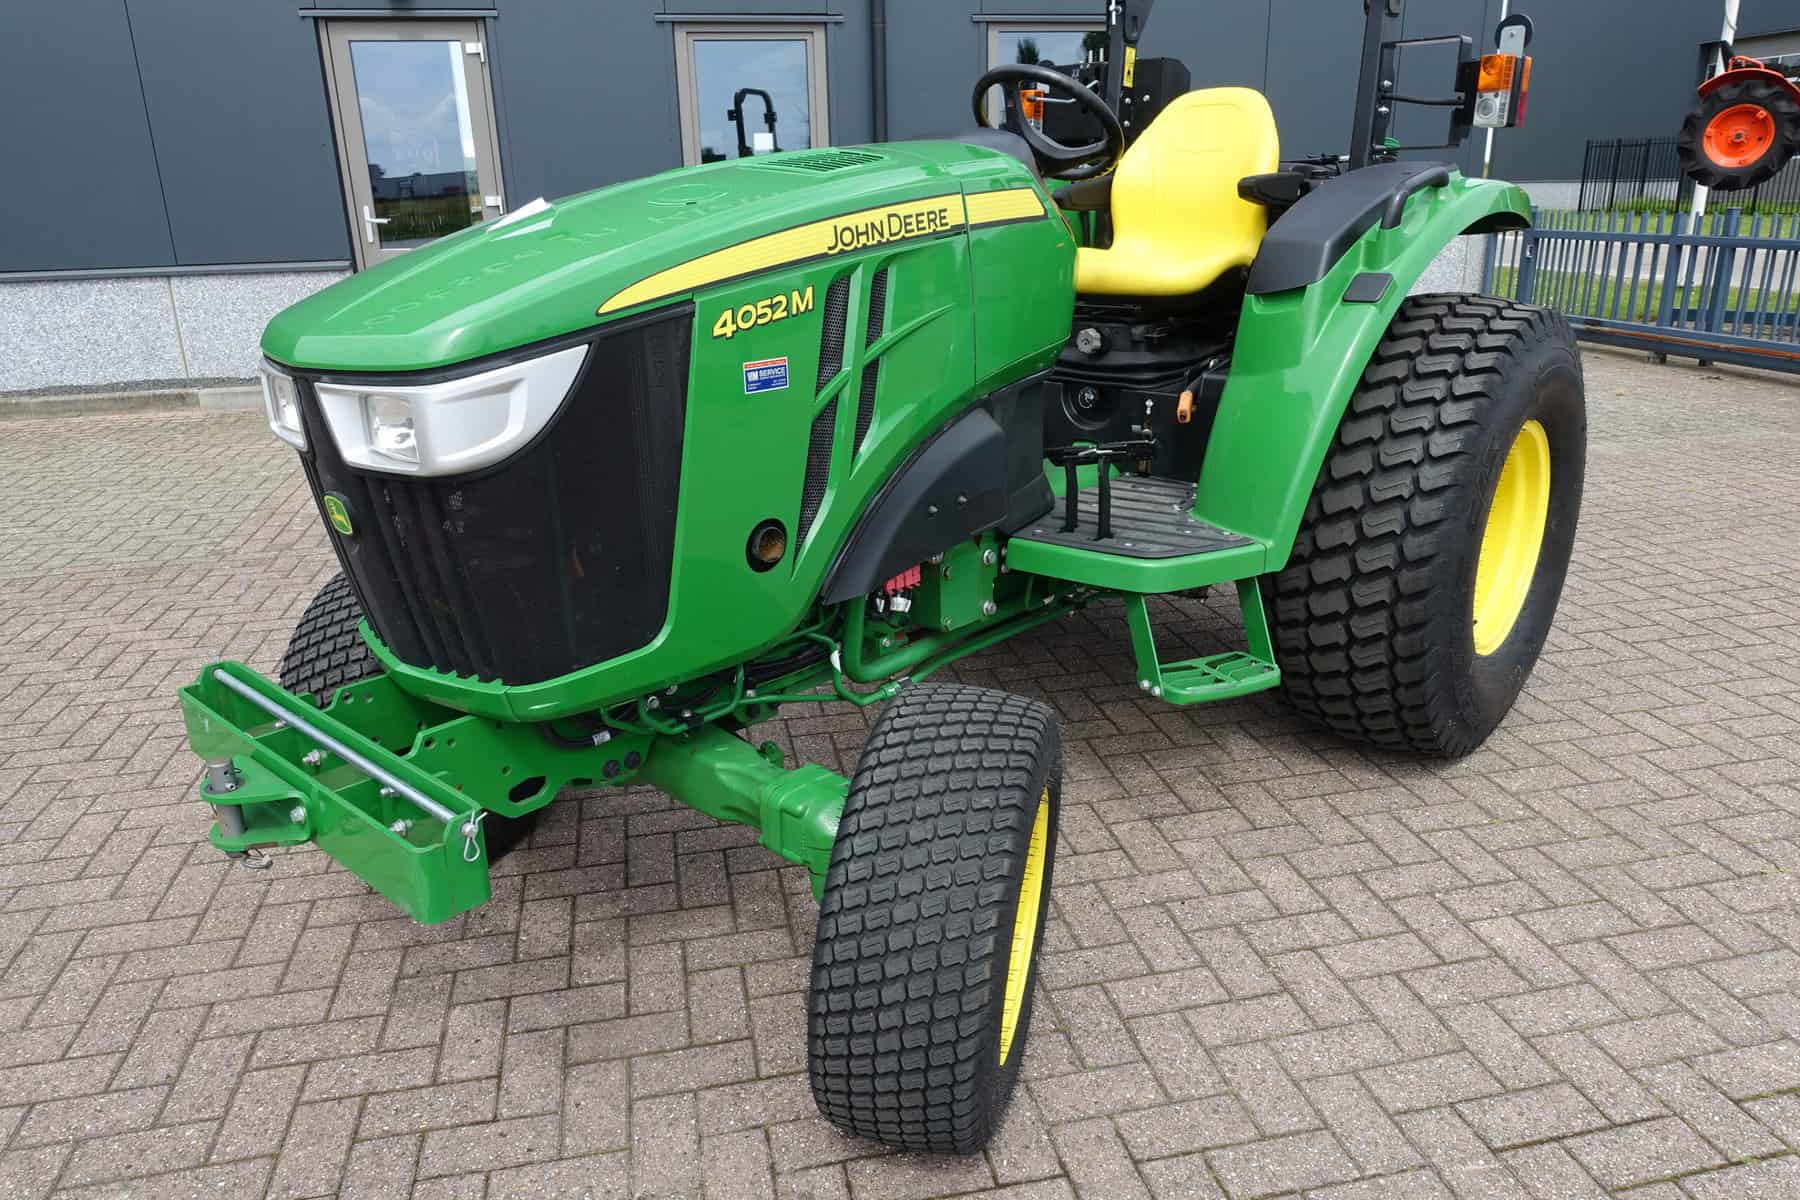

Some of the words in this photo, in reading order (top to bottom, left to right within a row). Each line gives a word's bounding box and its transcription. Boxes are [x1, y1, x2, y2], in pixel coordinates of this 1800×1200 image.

[827, 220, 885, 251] JOHN
[886, 208, 949, 238] DEERE
[712, 294, 788, 339] 4052
[791, 285, 814, 317] M
[759, 366, 786, 378] SERVICE
